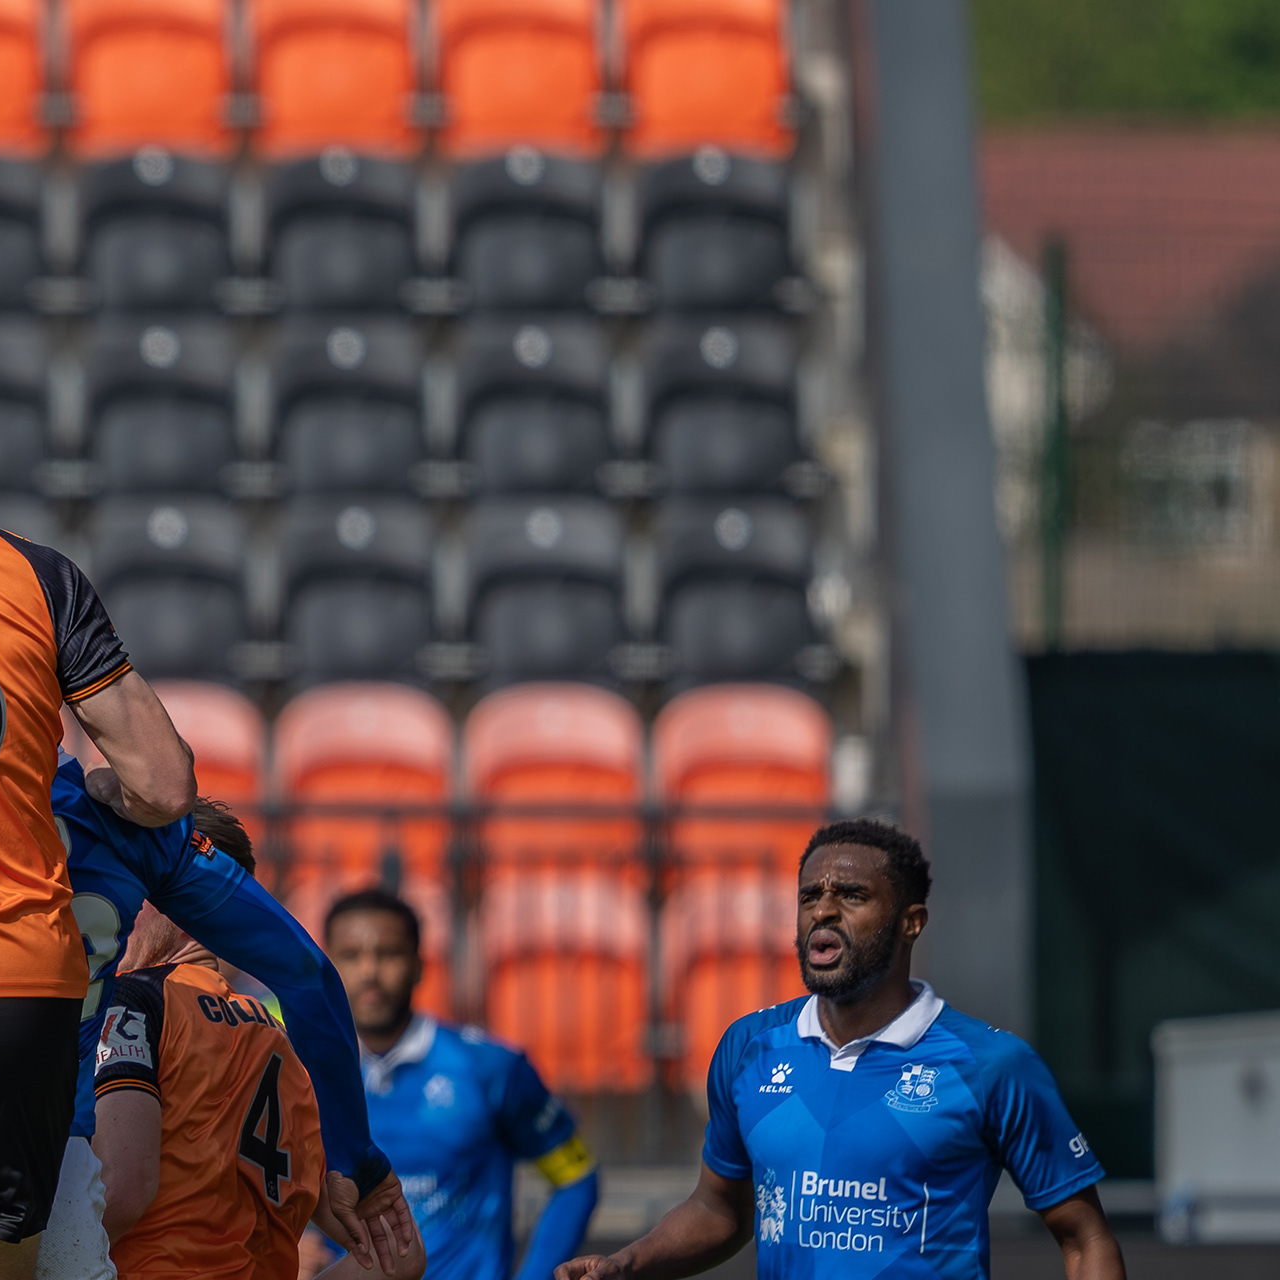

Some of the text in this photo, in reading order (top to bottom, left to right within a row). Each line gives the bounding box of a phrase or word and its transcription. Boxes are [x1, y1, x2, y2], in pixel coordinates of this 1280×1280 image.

[197, 994, 286, 1028] COLLI
[759, 1084, 793, 1094] KELME
[238, 1050, 291, 1207] 4
[801, 1170, 888, 1201] Brunel
[800, 1198, 918, 1235] University
[799, 1223, 884, 1253] London
